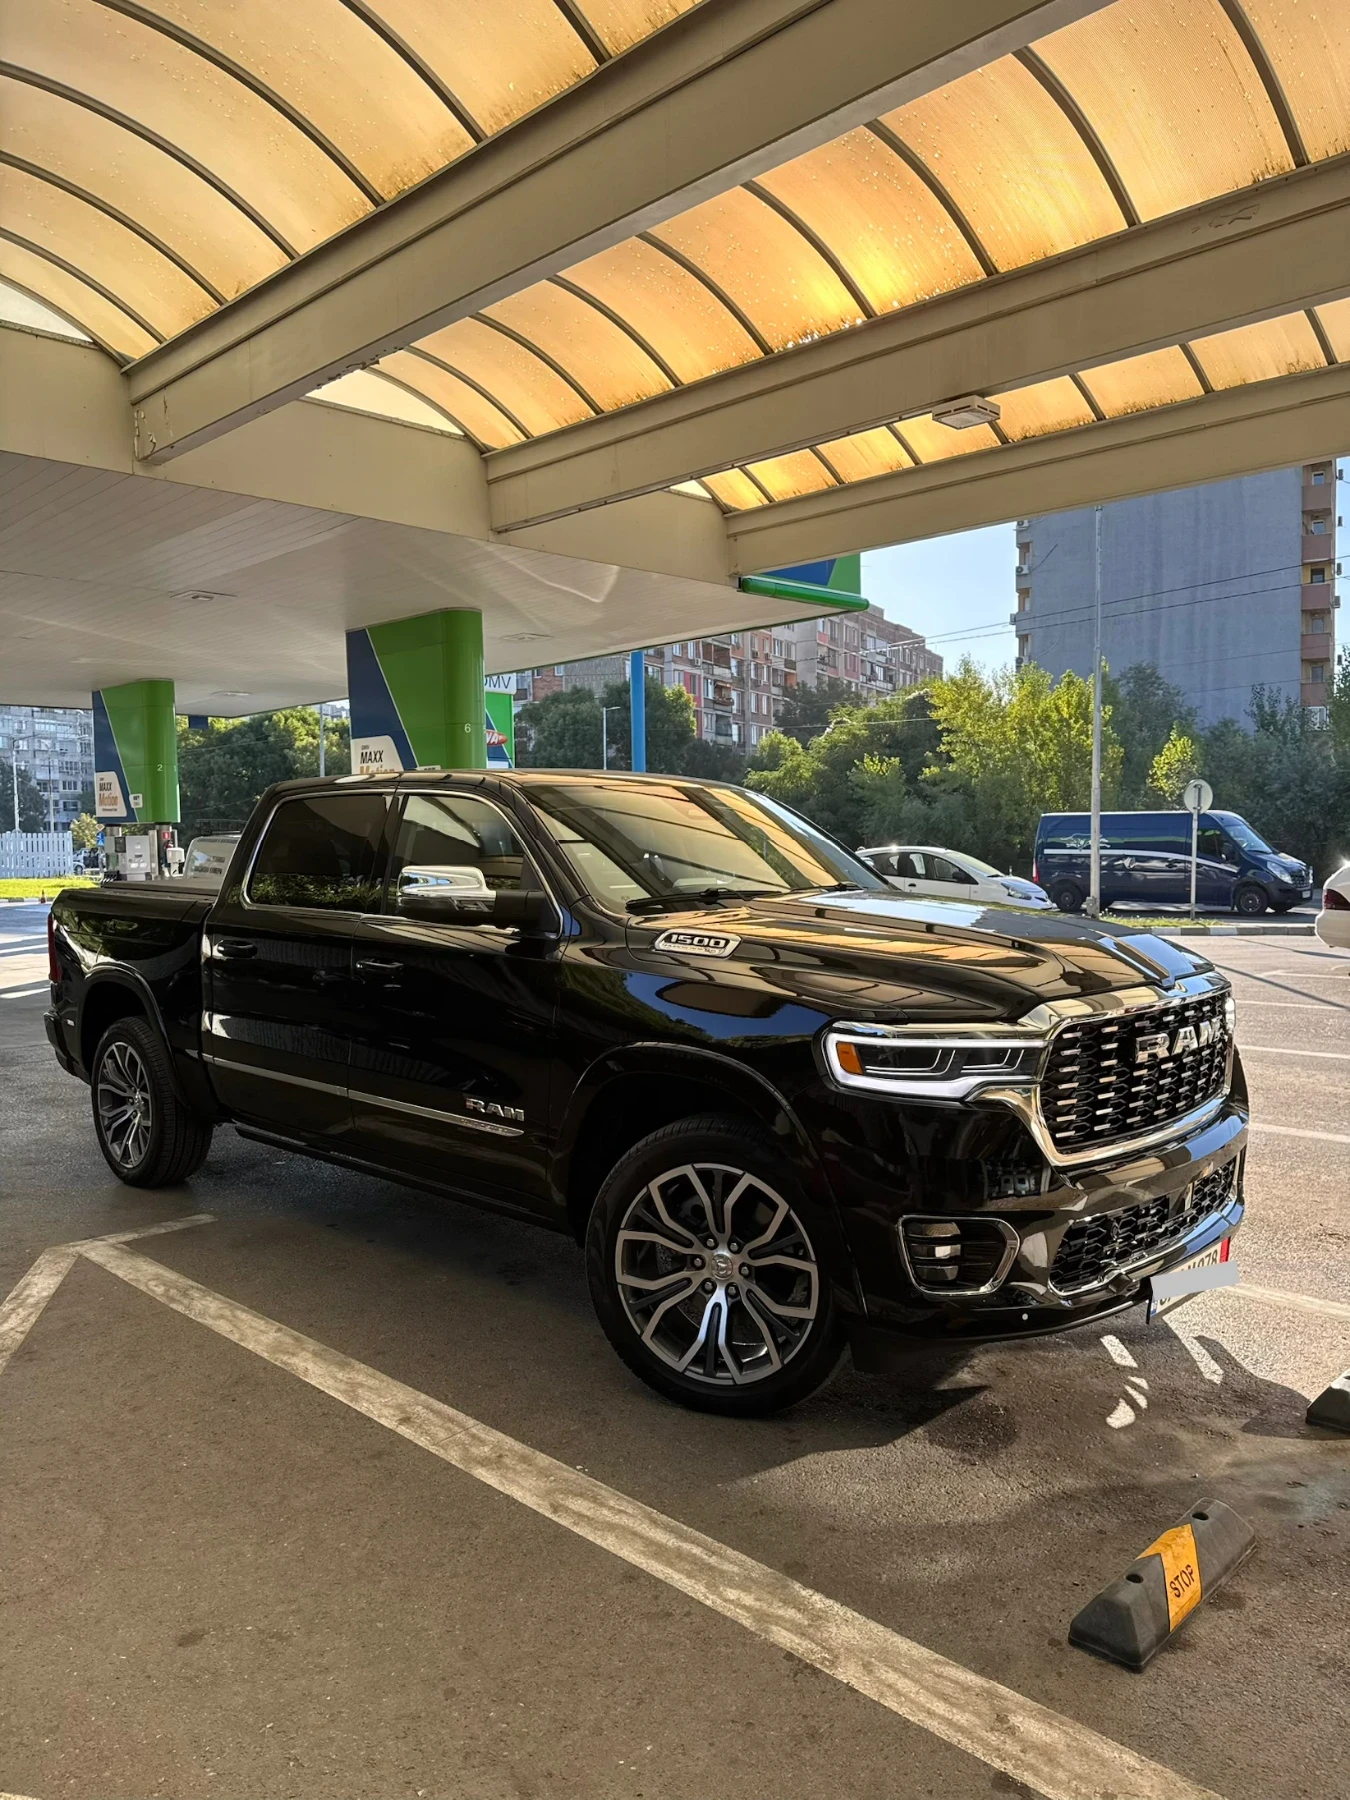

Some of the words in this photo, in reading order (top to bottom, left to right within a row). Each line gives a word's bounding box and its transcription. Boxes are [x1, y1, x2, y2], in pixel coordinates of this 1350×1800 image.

[464, 723, 472, 734] 6
[360, 750, 384, 764] MAXX
[157, 763, 163, 772] 2
[99, 782, 112, 791] MAXX
[98, 792, 119, 807] Motion
[670, 934, 726, 948] 1500
[1135, 1015, 1223, 1064] RAM
[465, 1098, 525, 1121] RAM
[1169, 1564, 1195, 1598] STOP
